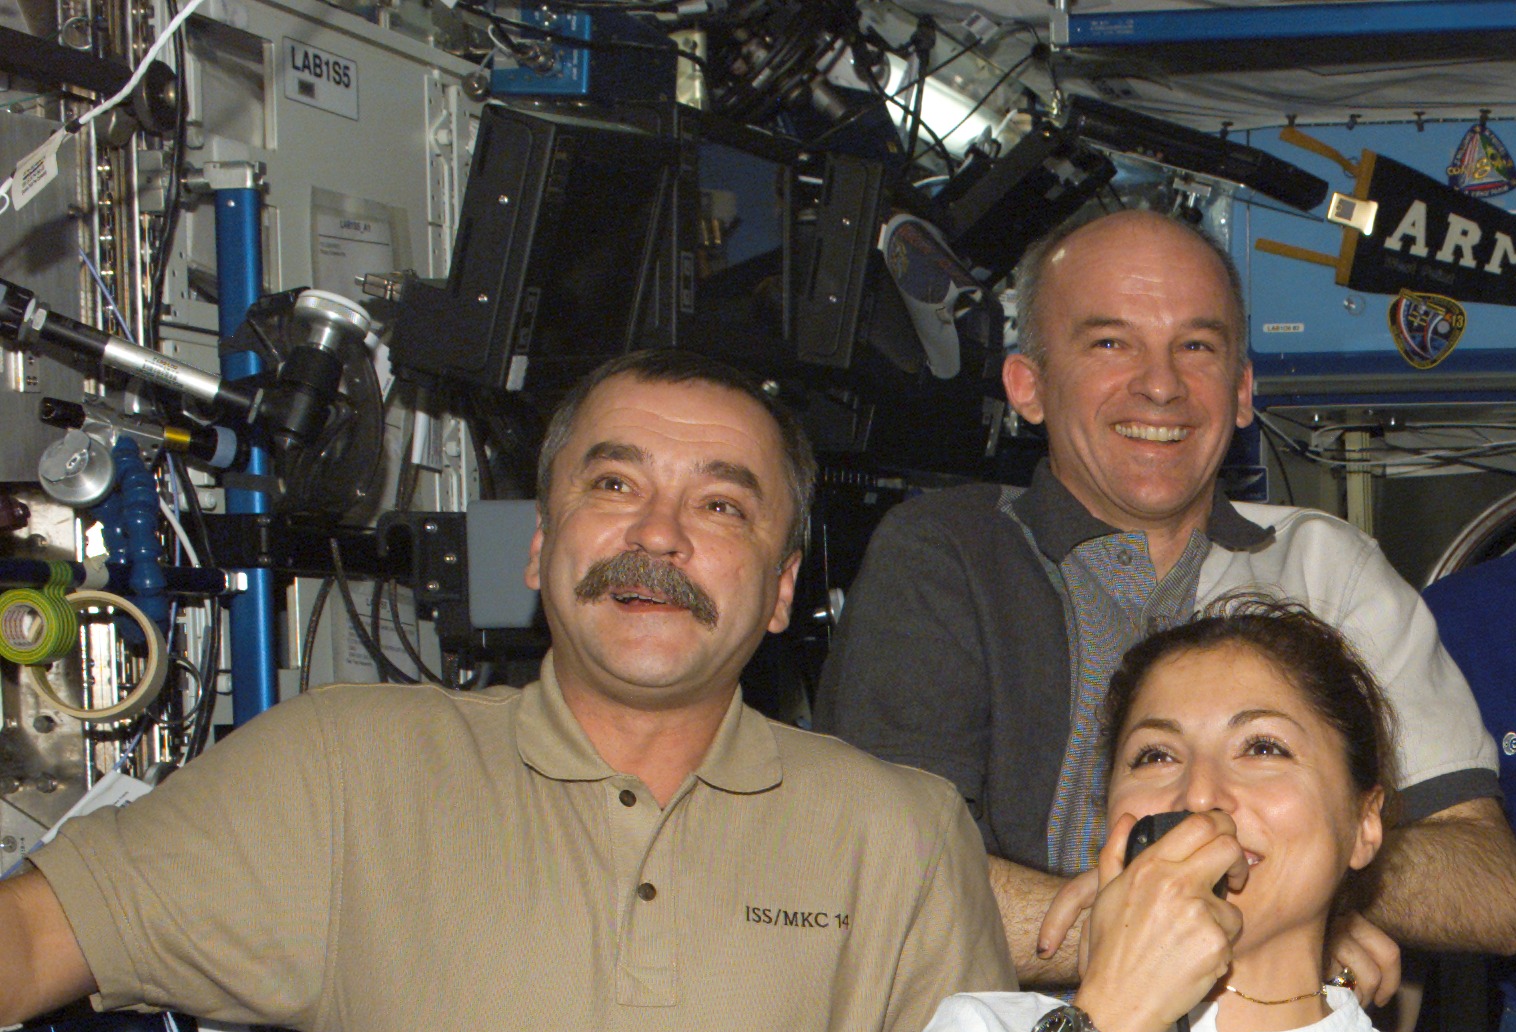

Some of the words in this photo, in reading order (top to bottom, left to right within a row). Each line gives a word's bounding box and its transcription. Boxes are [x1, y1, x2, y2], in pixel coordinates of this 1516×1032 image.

[290, 45, 352, 88] LAB1S5
[745, 905, 829, 928] ISS/MKC
[834, 913, 849, 930] 14
